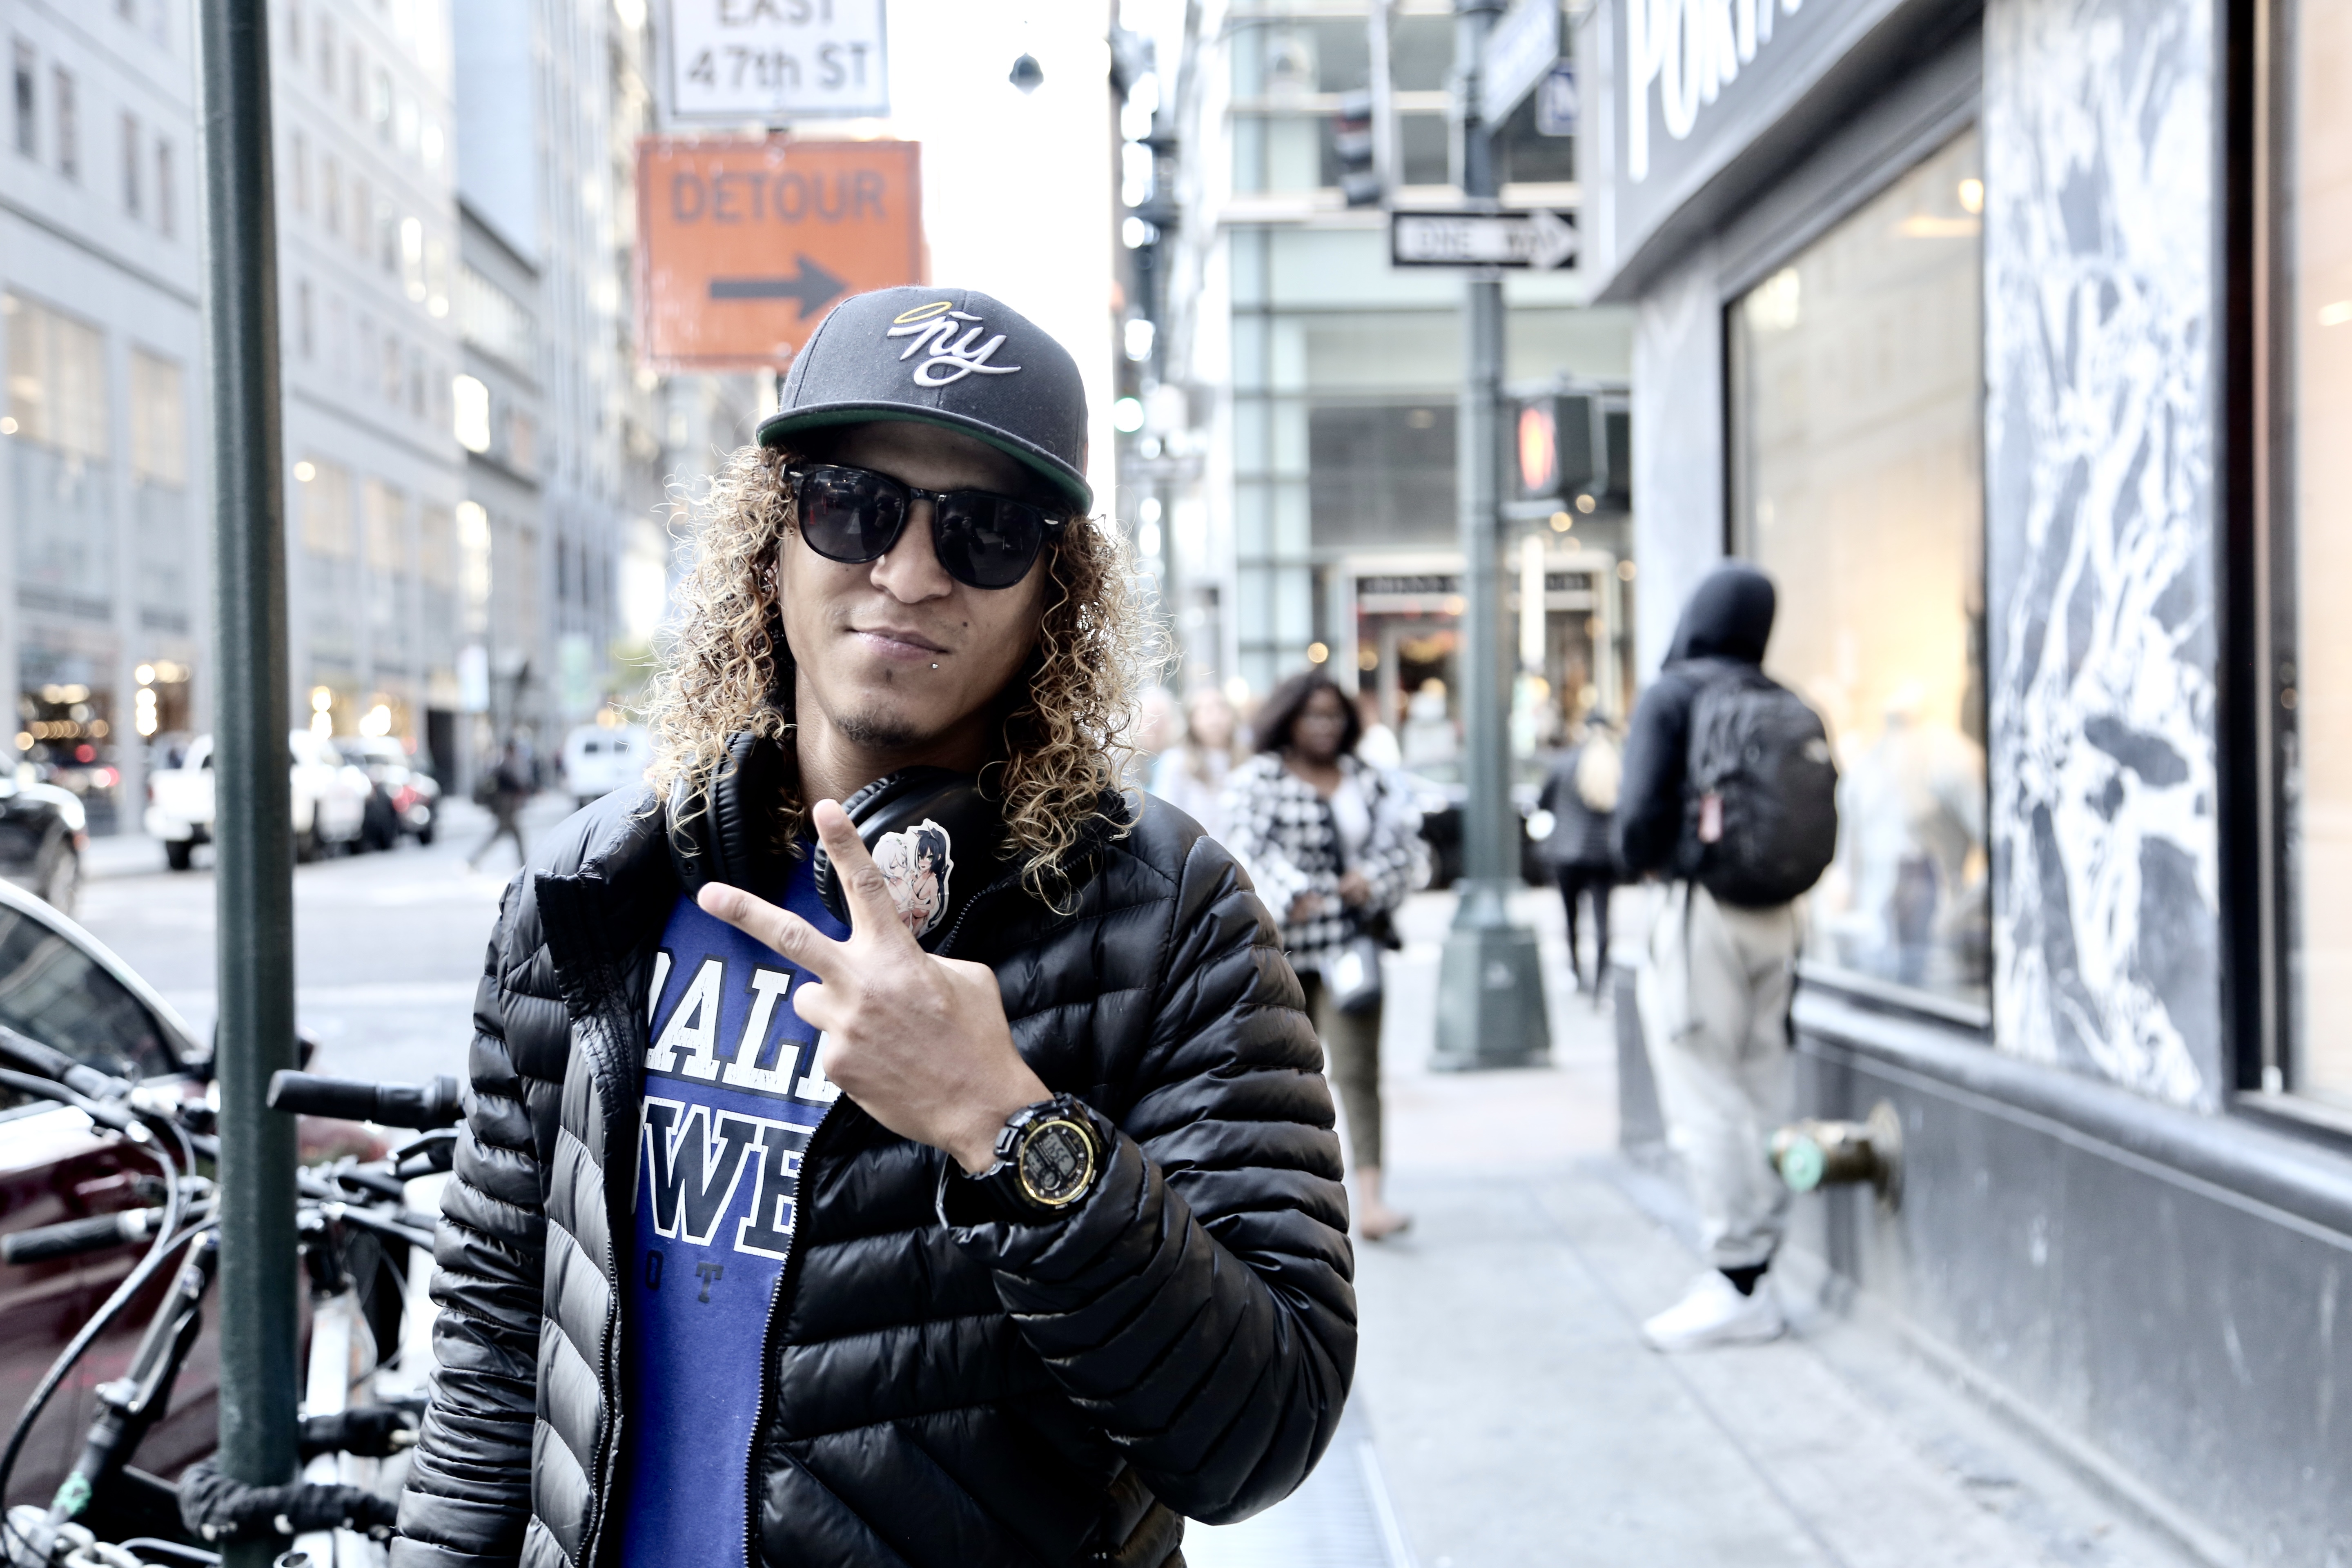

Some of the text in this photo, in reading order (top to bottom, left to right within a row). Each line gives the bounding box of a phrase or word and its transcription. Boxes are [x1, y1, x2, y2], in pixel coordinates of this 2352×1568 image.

[688, 43, 870, 88] 47th ST
[673, 170, 886, 225] DETOUR
